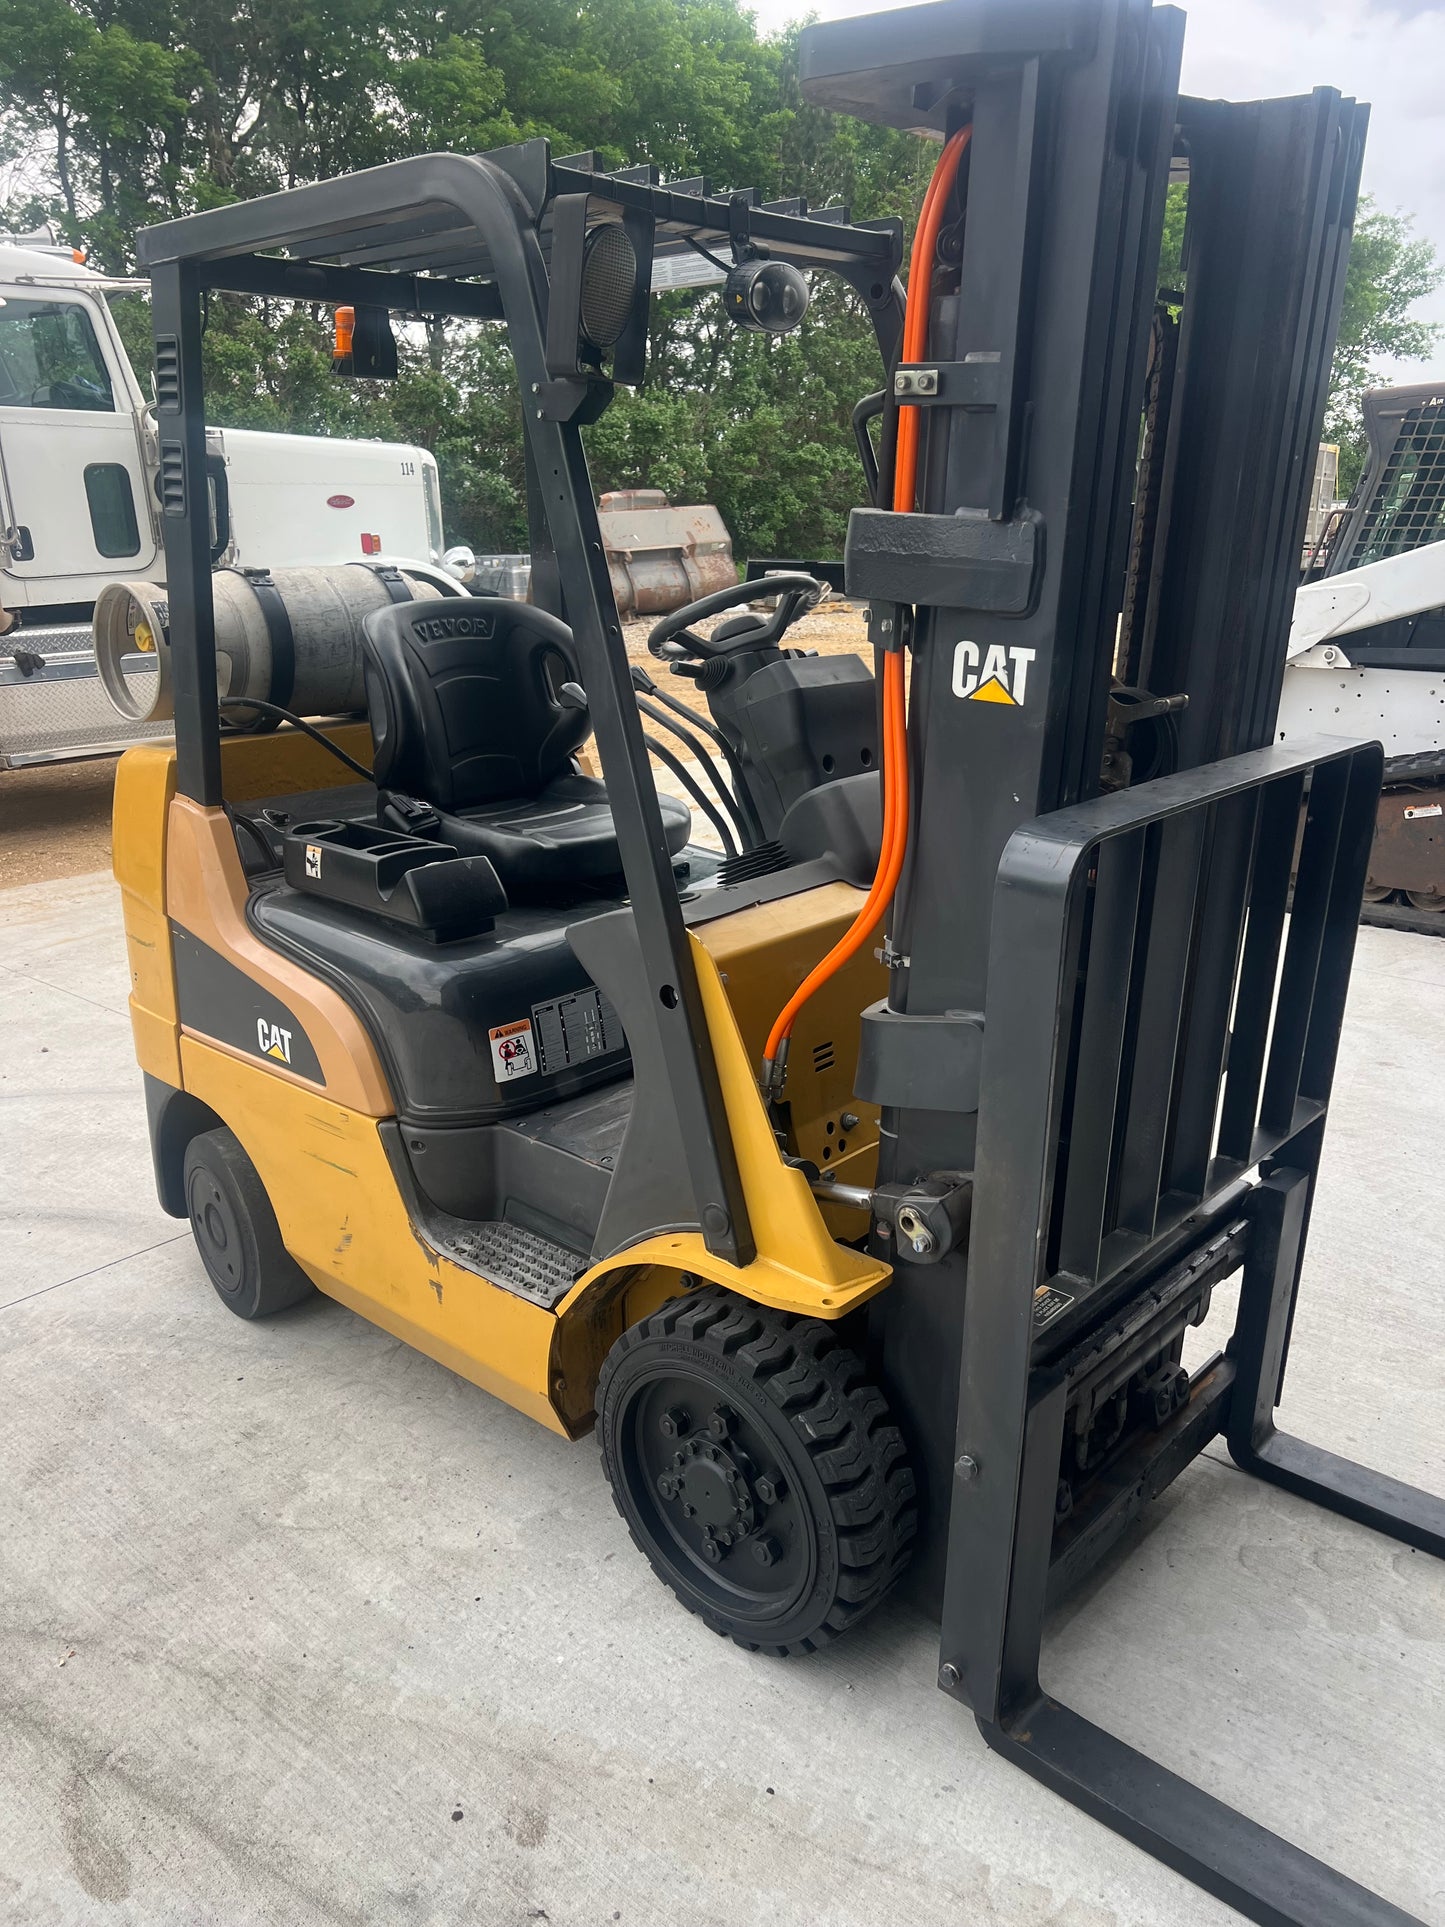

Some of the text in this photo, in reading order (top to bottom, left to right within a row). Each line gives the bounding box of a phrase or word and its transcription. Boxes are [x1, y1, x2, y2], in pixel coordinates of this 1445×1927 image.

[401, 462, 415, 476] 114
[413, 617, 488, 642] VEVOR
[952, 640, 1036, 706] CAT
[257, 1017, 292, 1065] CAT
[503, 1023, 528, 1037] WARNING
